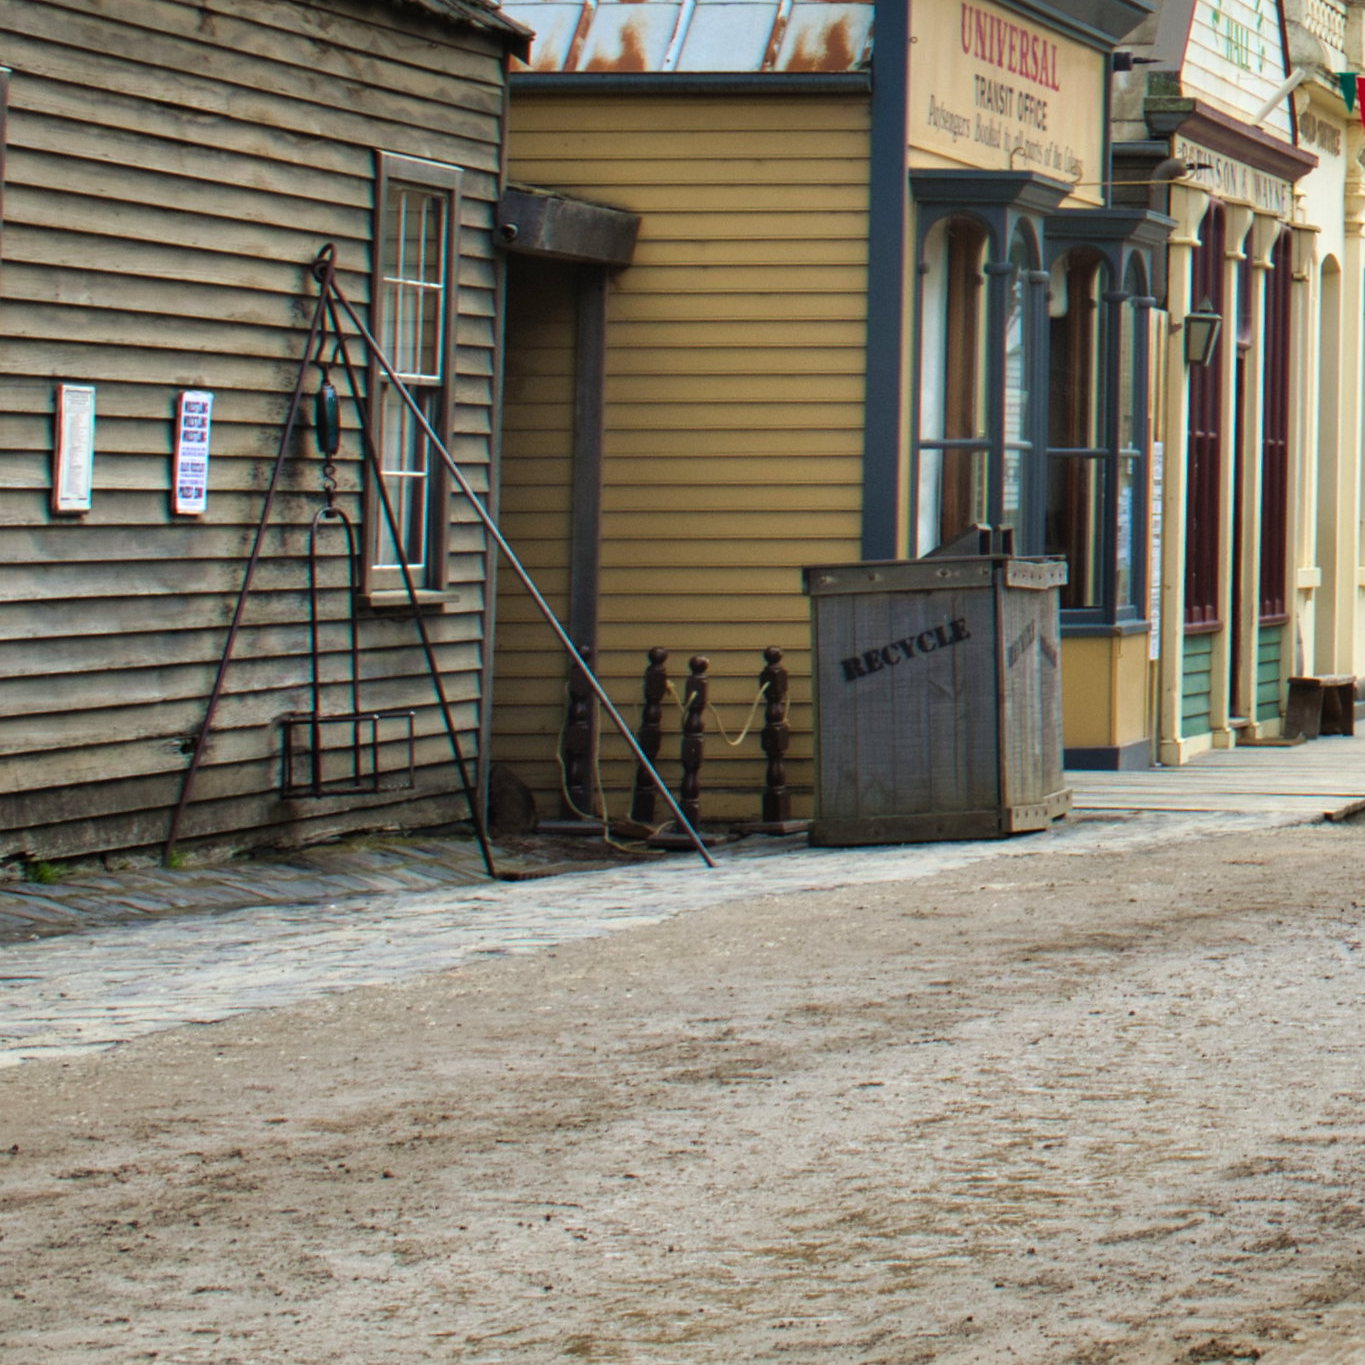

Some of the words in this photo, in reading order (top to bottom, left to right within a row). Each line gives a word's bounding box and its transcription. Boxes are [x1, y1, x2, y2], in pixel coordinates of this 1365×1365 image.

[961, 2, 1060, 92] UNIVERSAL
[974, 73, 1014, 118] TRANSIT
[1017, 91, 1048, 132] OFFICE
[841, 617, 972, 683] RECYCLE
